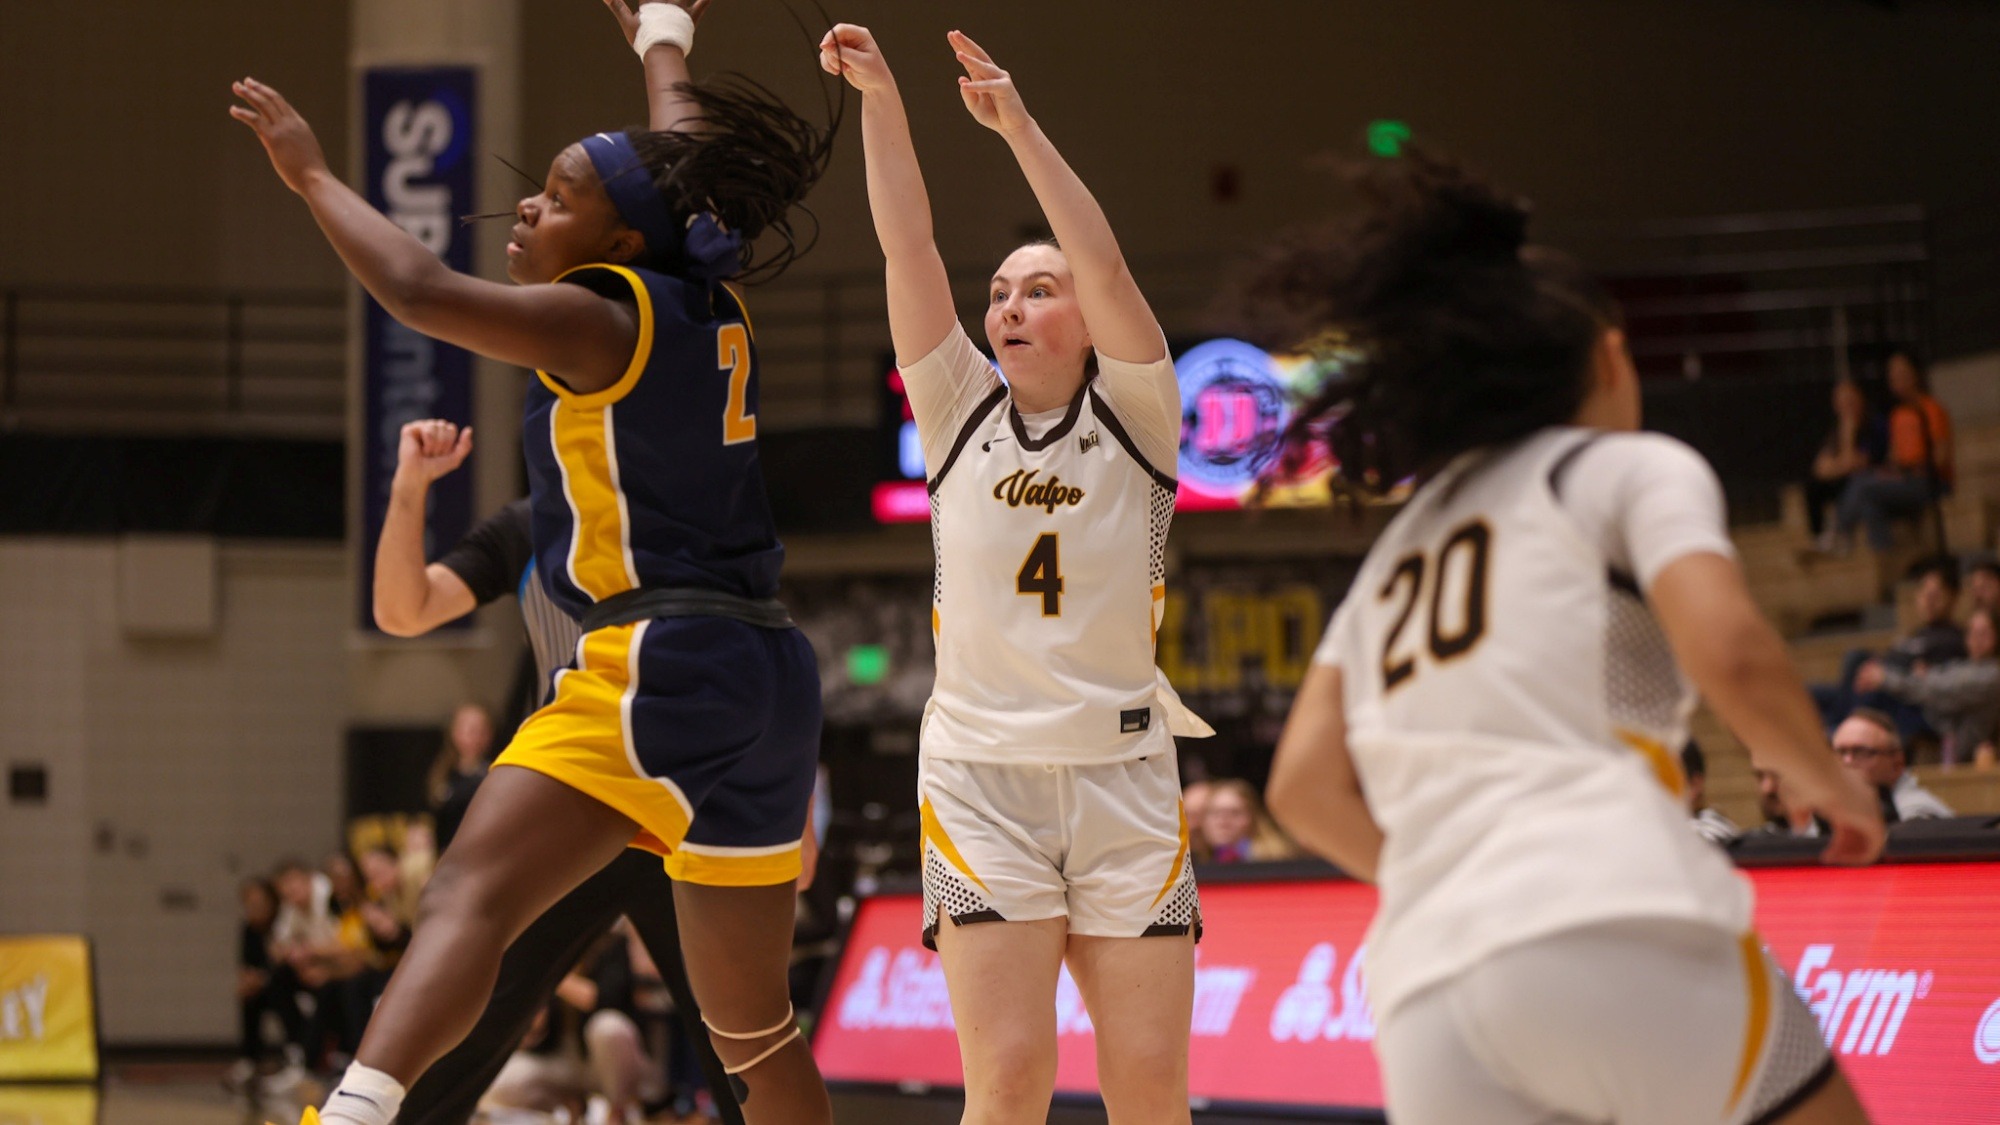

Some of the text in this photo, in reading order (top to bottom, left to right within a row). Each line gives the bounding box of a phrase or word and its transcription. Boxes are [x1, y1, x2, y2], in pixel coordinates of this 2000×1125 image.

[717, 322, 756, 446] 2
[992, 468, 1087, 515] Valpo
[1016, 532, 1065, 618] 4
[1378, 516, 1493, 694] 20
